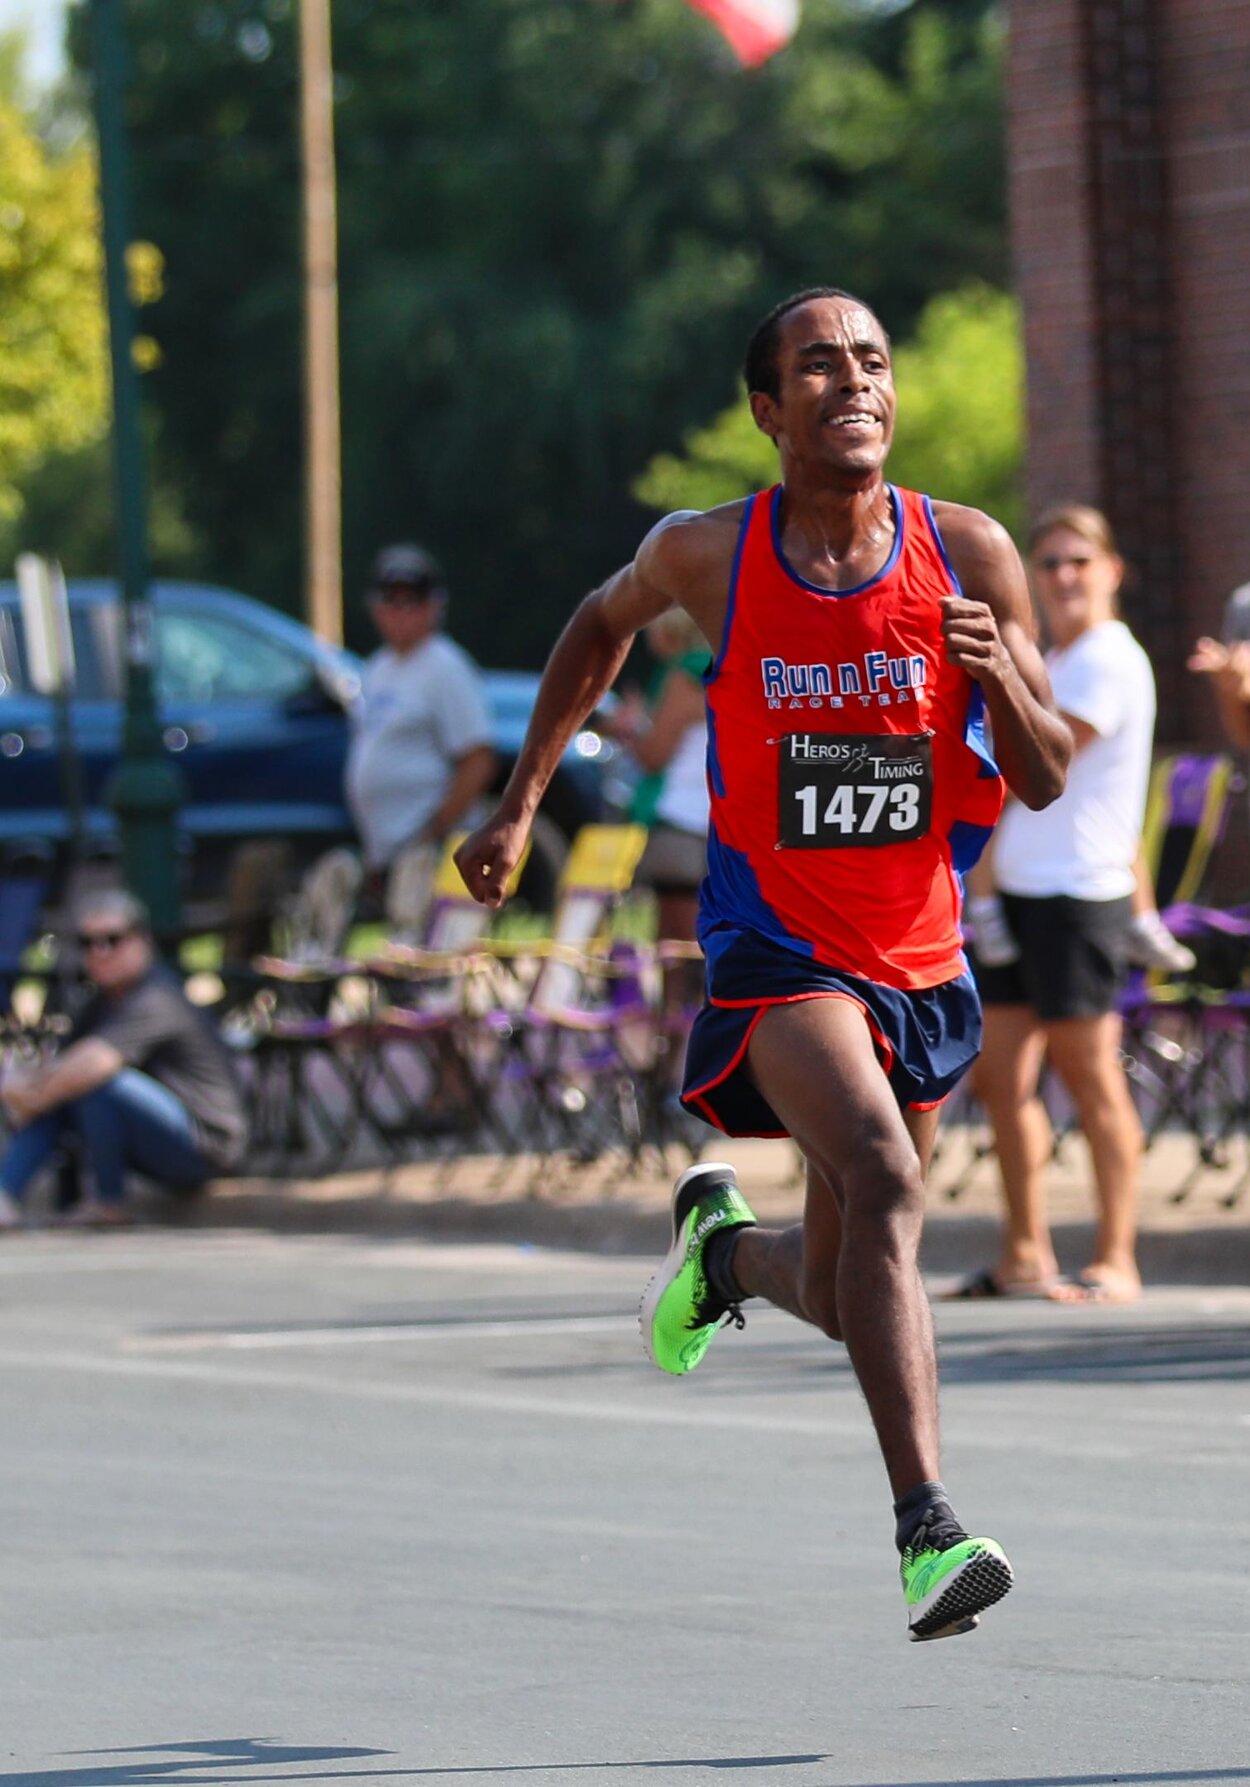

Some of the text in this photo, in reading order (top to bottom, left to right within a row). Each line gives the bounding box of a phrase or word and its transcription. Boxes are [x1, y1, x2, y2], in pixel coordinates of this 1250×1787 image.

[761, 651, 926, 697] Run n Fun
[768, 696, 844, 709] RACE
[868, 757, 924, 779] TIMING
[795, 783, 920, 835] 1473
